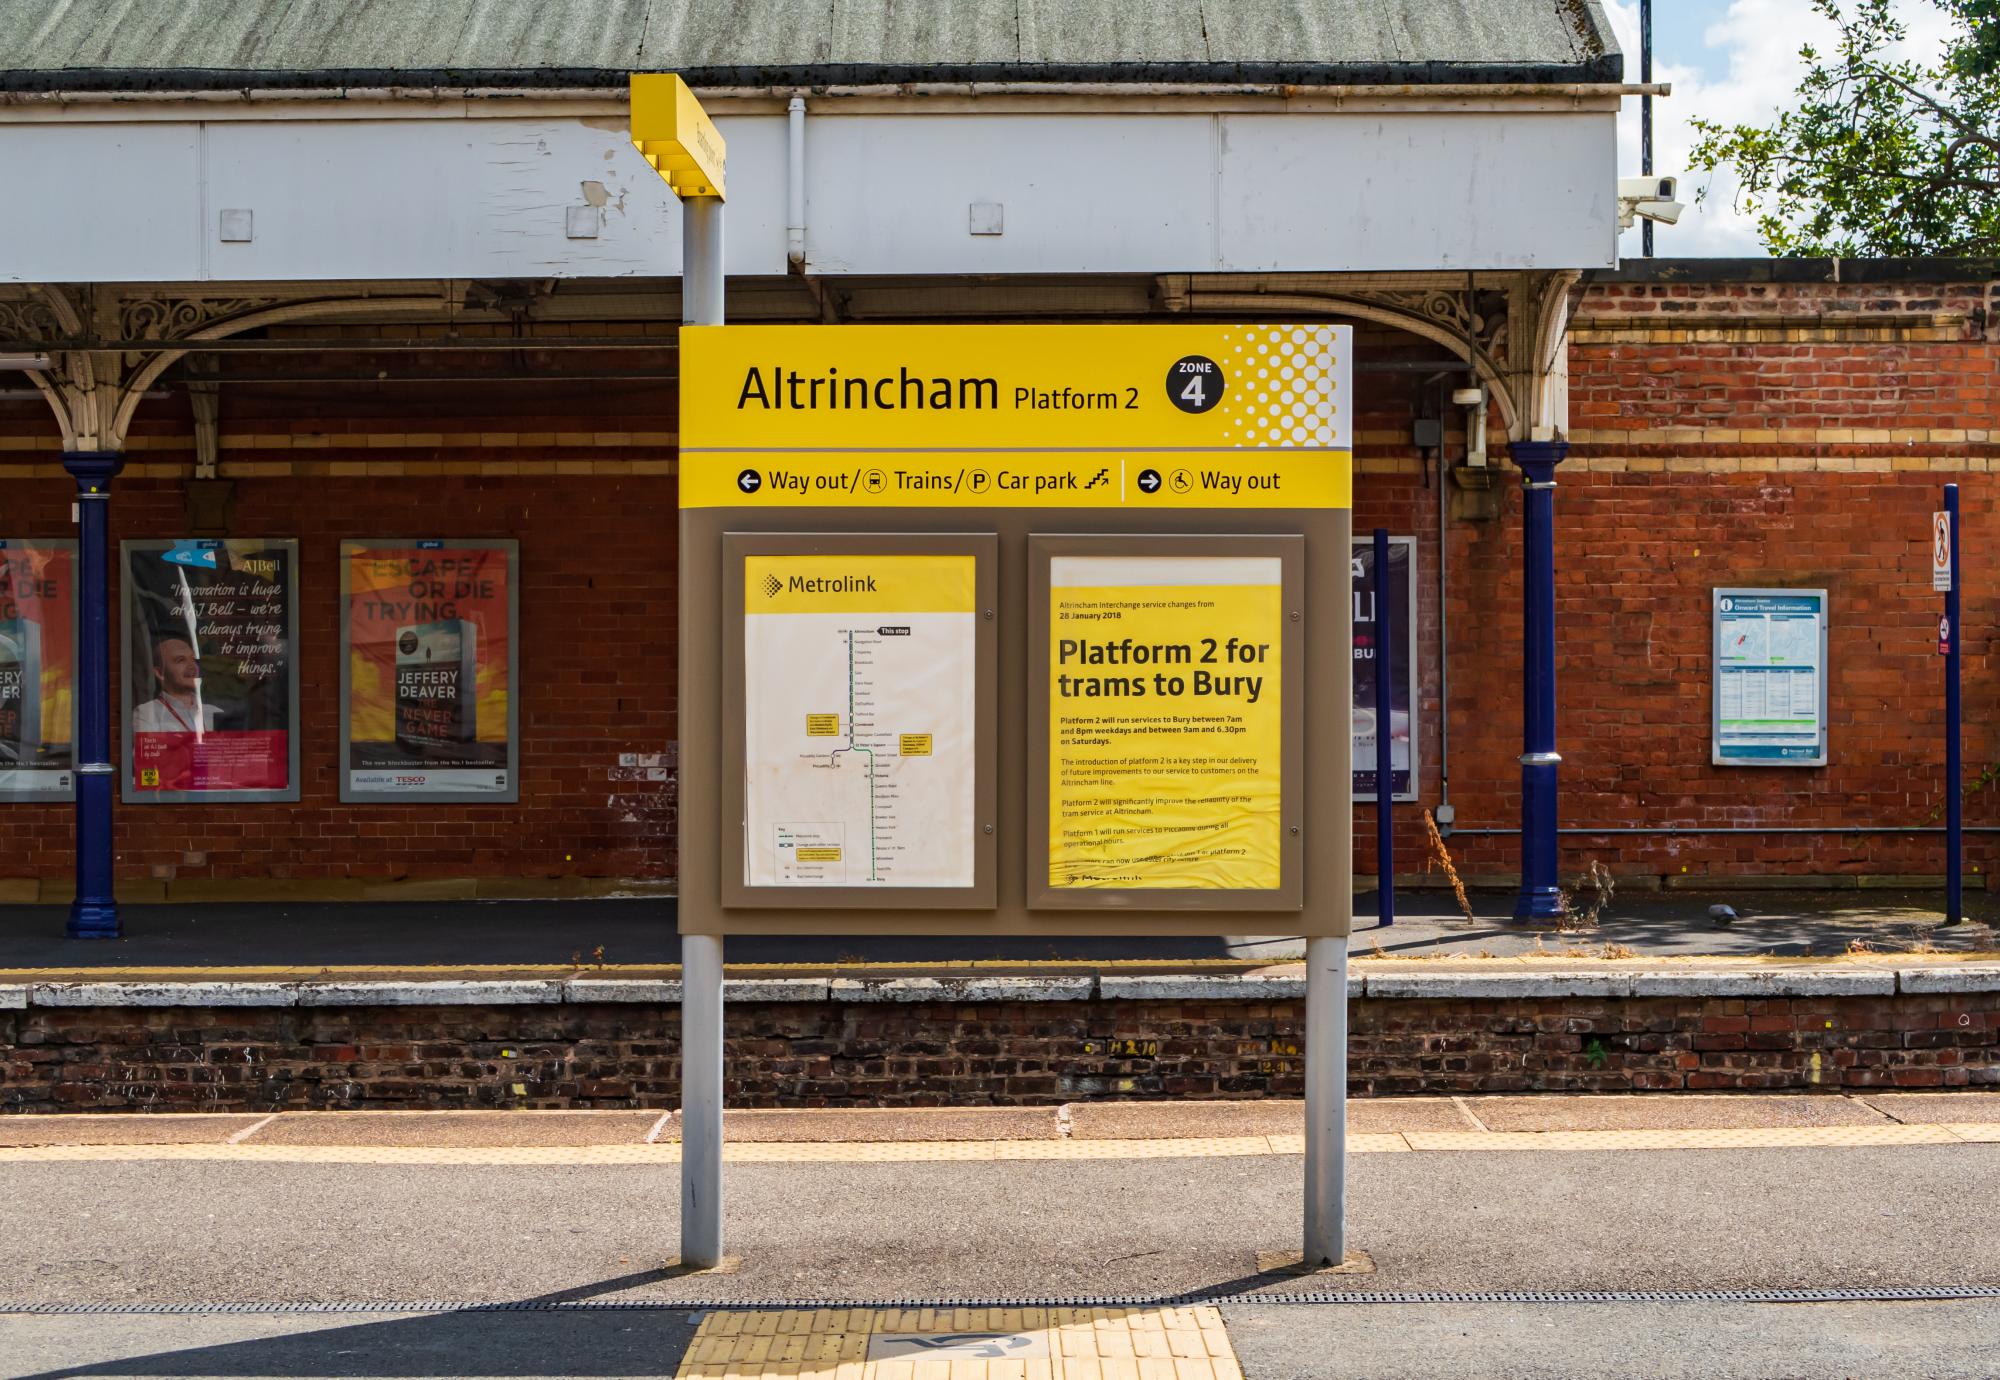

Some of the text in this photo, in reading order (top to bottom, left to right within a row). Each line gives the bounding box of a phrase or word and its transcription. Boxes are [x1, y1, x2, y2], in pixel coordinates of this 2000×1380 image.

[1179, 362, 1212, 373] ZONE
[737, 366, 1139, 410] Altrincham Platform 2
[1180, 375, 1206, 406] 4
[769, 472, 810, 494] Way
[998, 472, 1025, 491] Car
[1032, 471, 1077, 494] park
[1200, 472, 1280, 494] Way out
[239, 582, 249, 596] is
[252, 580, 282, 601] huge
[408, 580, 495, 599] OR DIE
[788, 576, 877, 592] Metrolink
[208, 602, 234, 616] Bell
[1060, 601, 1098, 609] Altrincham
[1099, 601, 1141, 610] Interchange
[1168, 601, 1196, 610] changes
[1198, 600, 1215, 608] from
[1060, 612, 1070, 620] 28
[1072, 612, 1101, 622] January
[200, 621, 282, 642] always trying
[895, 628, 909, 636] stop
[221, 642, 282, 660] to improve
[1060, 638, 1270, 665] Platform 2 for
[398, 670, 459, 684] JEFFERY
[400, 686, 456, 699] DEAVER
[1058, 670, 1263, 704] trams to Bury
[1061, 717, 1094, 725] Platform
[1131, 716, 1162, 724] services
[1173, 716, 1190, 725] Bury
[406, 724, 449, 737] GAME
[1076, 727, 1093, 736] 8pm
[1095, 726, 1132, 736] weekdays
[1133, 726, 1147, 734] and
[1149, 726, 1181, 734] between
[1217, 726, 1246, 735] 6.30pm
[1071, 738, 1112, 747] Saturdays.
[1061, 758, 1074, 766] The
[1129, 758, 1159, 766] platform
[1179, 758, 1191, 766] key
[1192, 758, 1207, 766] step
[1230, 757, 1257, 766] delivery
[1092, 768, 1142, 777] improvements
[1113, 798, 1154, 807] significantly
[1155, 798, 1183, 806] improve
